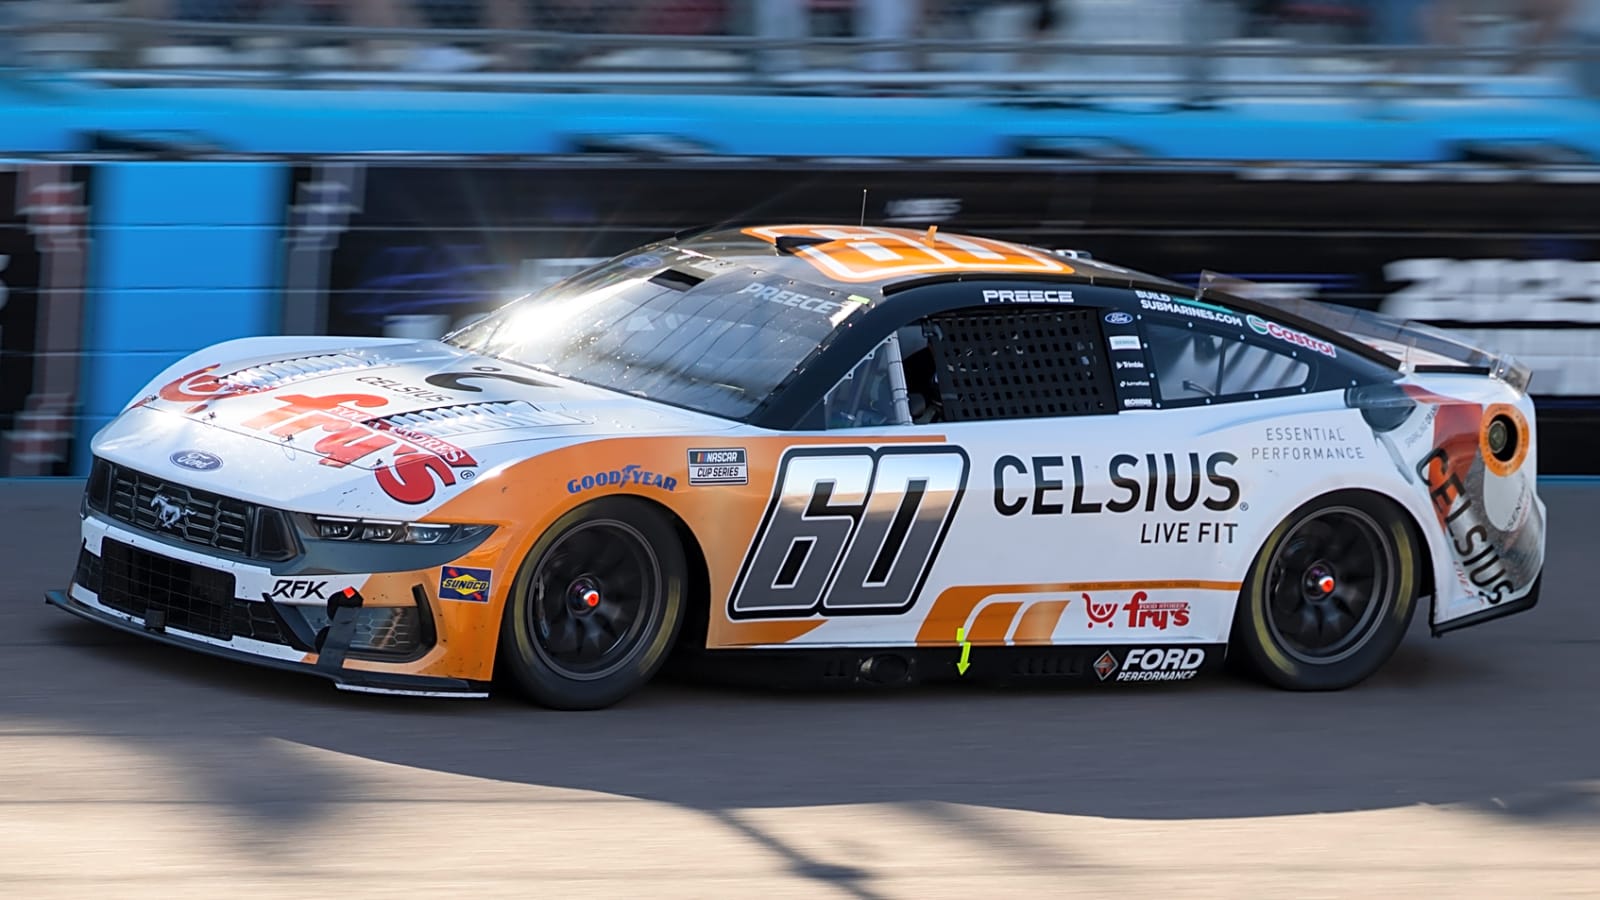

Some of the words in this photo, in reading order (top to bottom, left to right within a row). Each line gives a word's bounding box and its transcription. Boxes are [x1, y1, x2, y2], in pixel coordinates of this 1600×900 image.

[737, 282, 846, 314] PREECE
[982, 290, 1074, 303] PREECE
[1135, 290, 1171, 302] BUILD
[1107, 312, 1132, 323] Ford
[1140, 299, 1243, 327] SUBMARINES.COM
[1267, 321, 1337, 358] Castrol
[356, 376, 454, 402] CELSIUS
[1265, 427, 1345, 442] ESSENTIAL
[173, 451, 219, 470] Ford
[706, 451, 738, 463] NASCAR
[1251, 446, 1364, 461] PERFORMANCE
[567, 464, 677, 492] GOODYEAR
[697, 468, 713, 477] CUP
[713, 467, 739, 477] SERIES
[993, 452, 1240, 516] CELSIUS
[727, 444, 970, 621] 60
[1140, 523, 1189, 544] LIVE
[1199, 523, 1239, 543] FIT
[1416, 447, 1515, 605] CELSIUS
[271, 579, 328, 600] RFK
[443, 578, 489, 591] SUNOCO
[1122, 591, 1190, 630] fry's
[1121, 648, 1205, 671] FORD
[1115, 670, 1198, 681] PERFORMANCE
